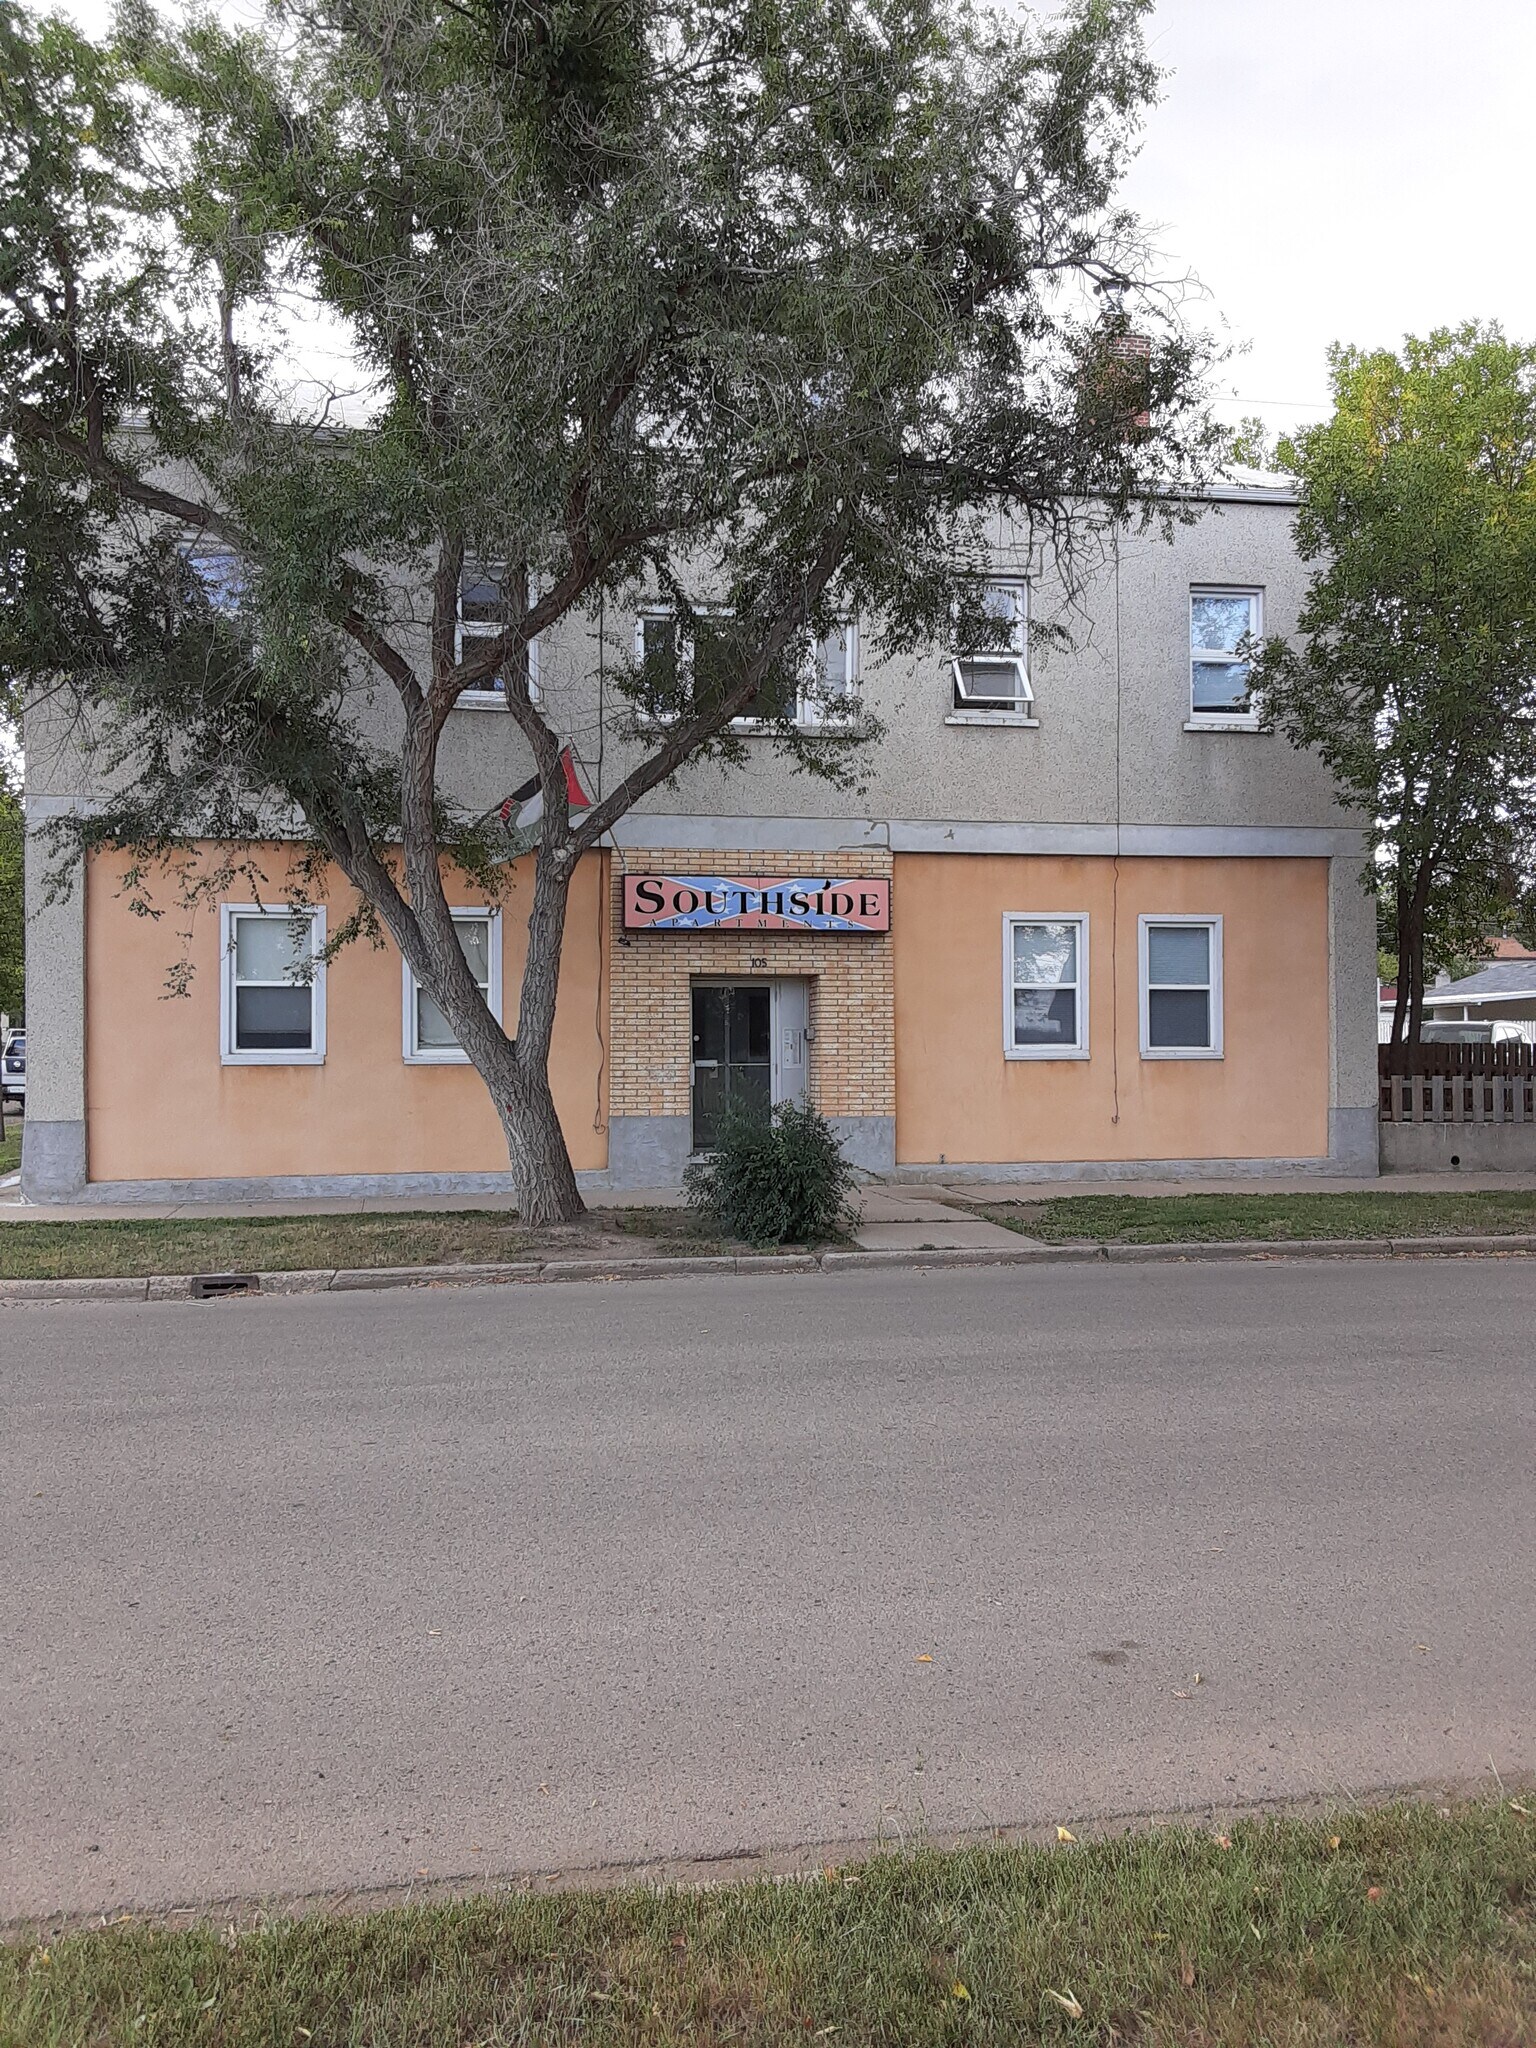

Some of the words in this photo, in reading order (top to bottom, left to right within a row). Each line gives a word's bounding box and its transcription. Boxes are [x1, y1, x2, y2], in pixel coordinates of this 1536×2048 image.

[634, 879, 881, 916] SOUTHSIDE
[649, 917, 855, 929] APARTMENTS
[751, 957, 768, 968] 105
